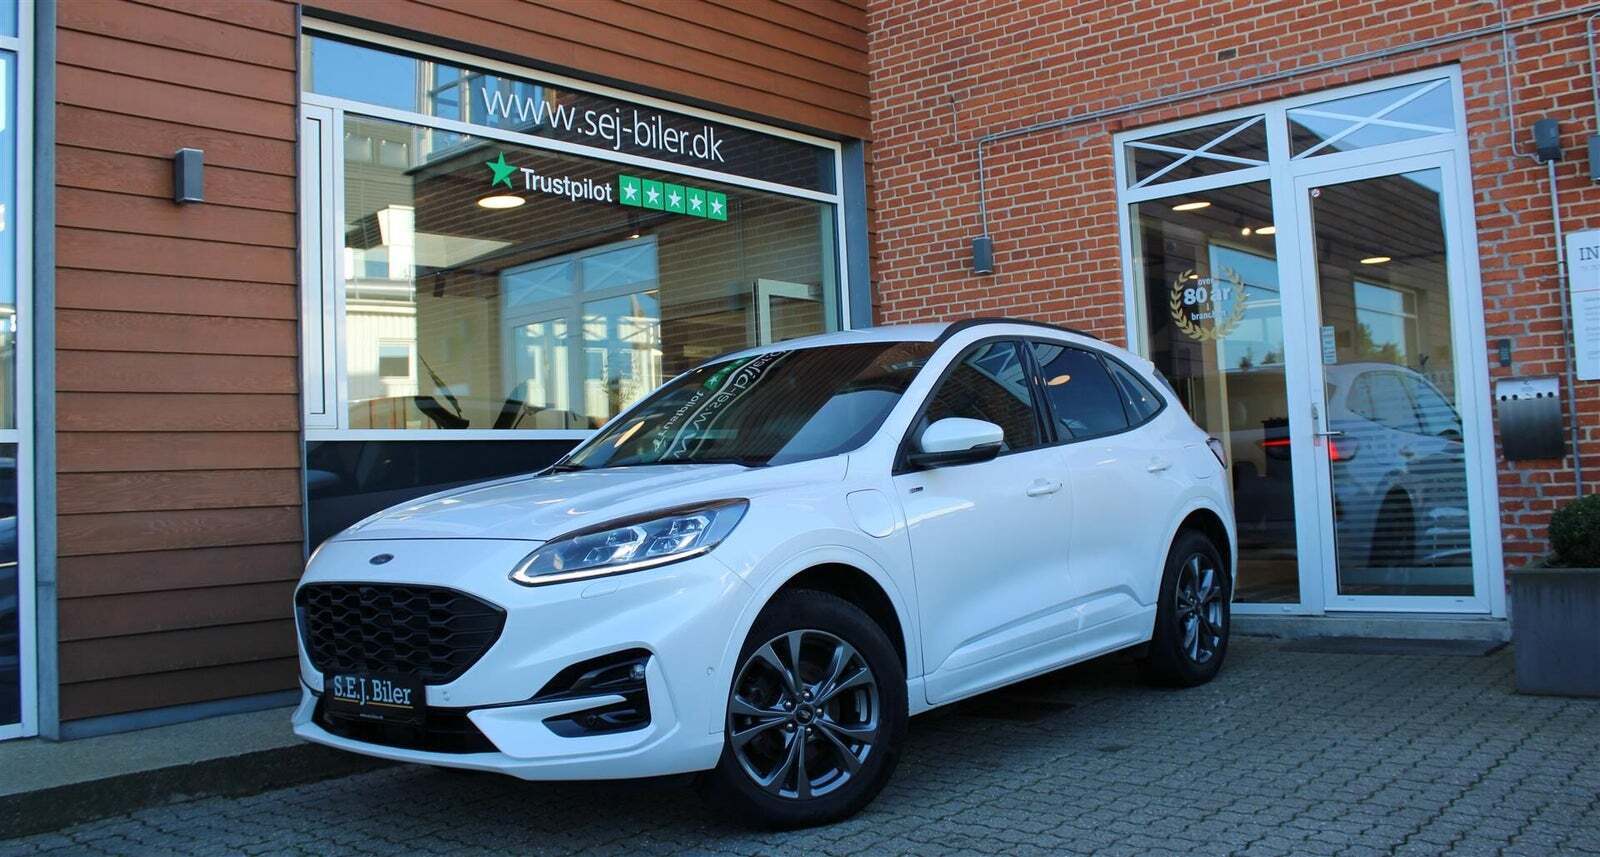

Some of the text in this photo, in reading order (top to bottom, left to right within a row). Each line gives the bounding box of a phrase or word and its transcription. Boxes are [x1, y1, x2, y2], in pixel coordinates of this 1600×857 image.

[482, 87, 725, 163] www.sej-biler.dk
[520, 167, 613, 203] Trustpilot
[1183, 286, 1208, 305] 80
[333, 675, 412, 706] S.E.J. Biler
